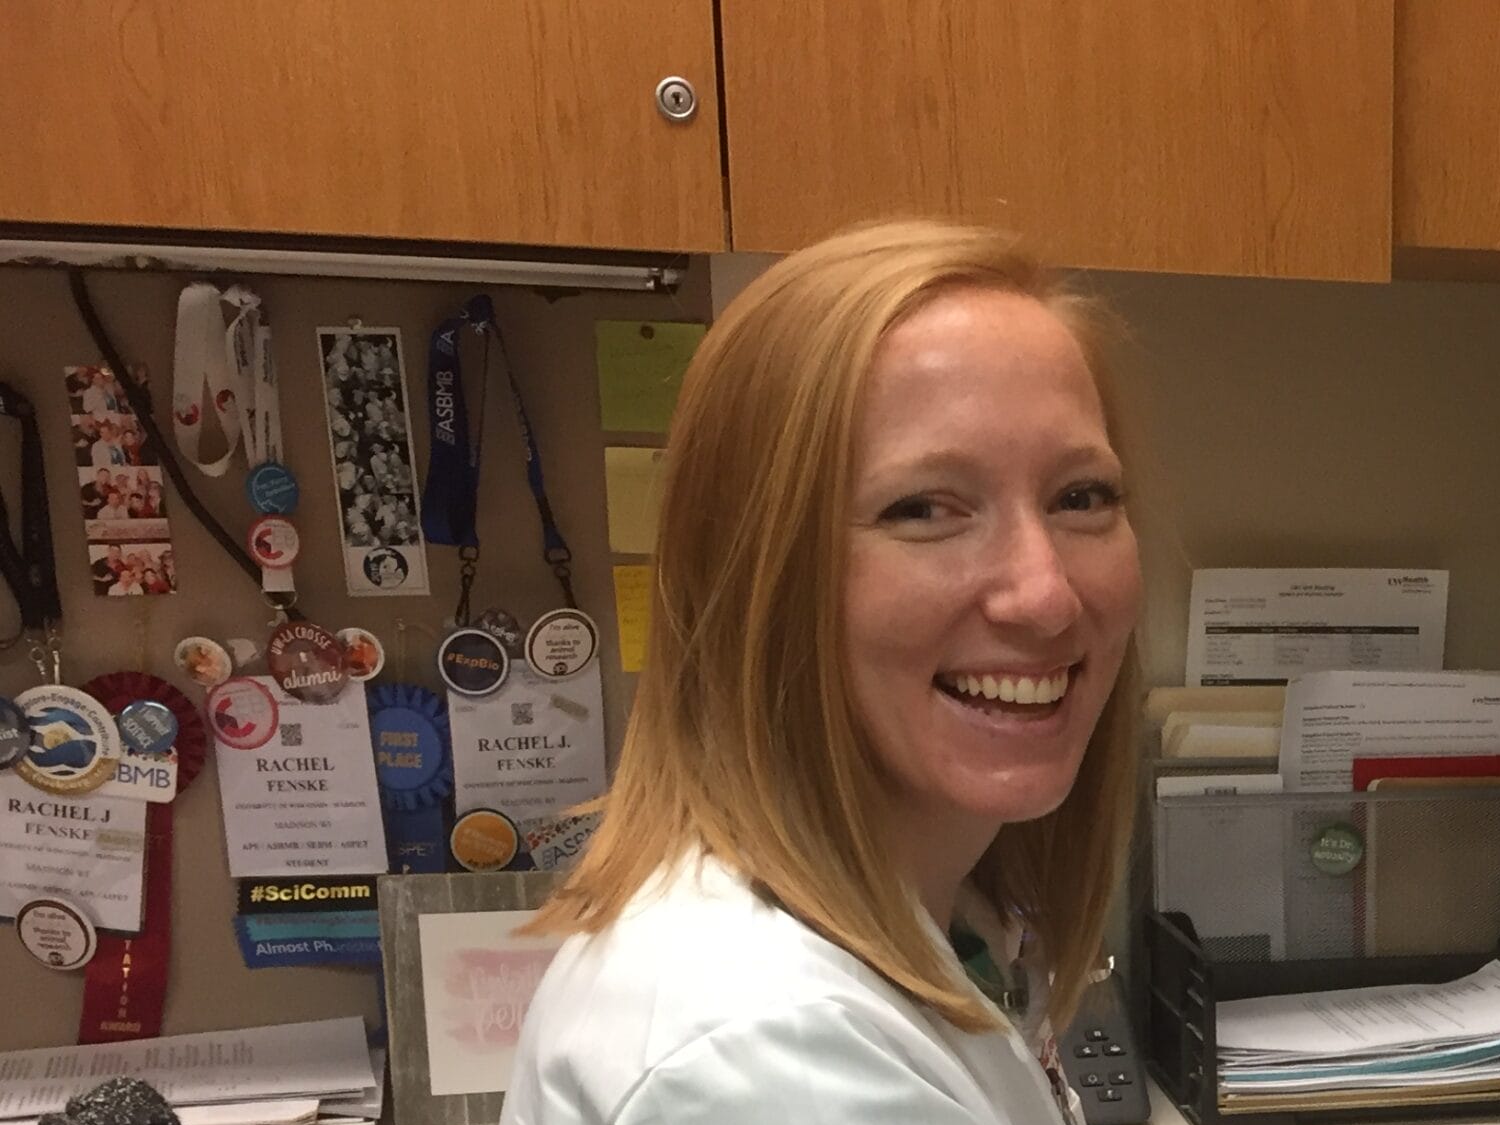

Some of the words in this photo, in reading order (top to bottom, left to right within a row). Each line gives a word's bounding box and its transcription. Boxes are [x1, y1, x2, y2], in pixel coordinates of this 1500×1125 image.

[434, 370, 455, 433] ASBMB
[295, 625, 332, 650] CROSSE
[447, 653, 499, 671] #ExpBio
[283, 668, 343, 690] alumni
[380, 731, 418, 747] FIRST
[478, 735, 549, 752] RACHEL
[557, 736, 571, 749] J.
[256, 757, 336, 773] RACHEL
[378, 752, 422, 769] PLACE
[497, 756, 556, 771] FENSKE
[267, 779, 329, 793] FENSKE
[8, 798, 95, 822] RACHEL
[100, 809, 111, 824] J
[25, 822, 95, 841] FENSKE
[251, 883, 370, 902] #SciComm
[256, 942, 308, 956] Almost
